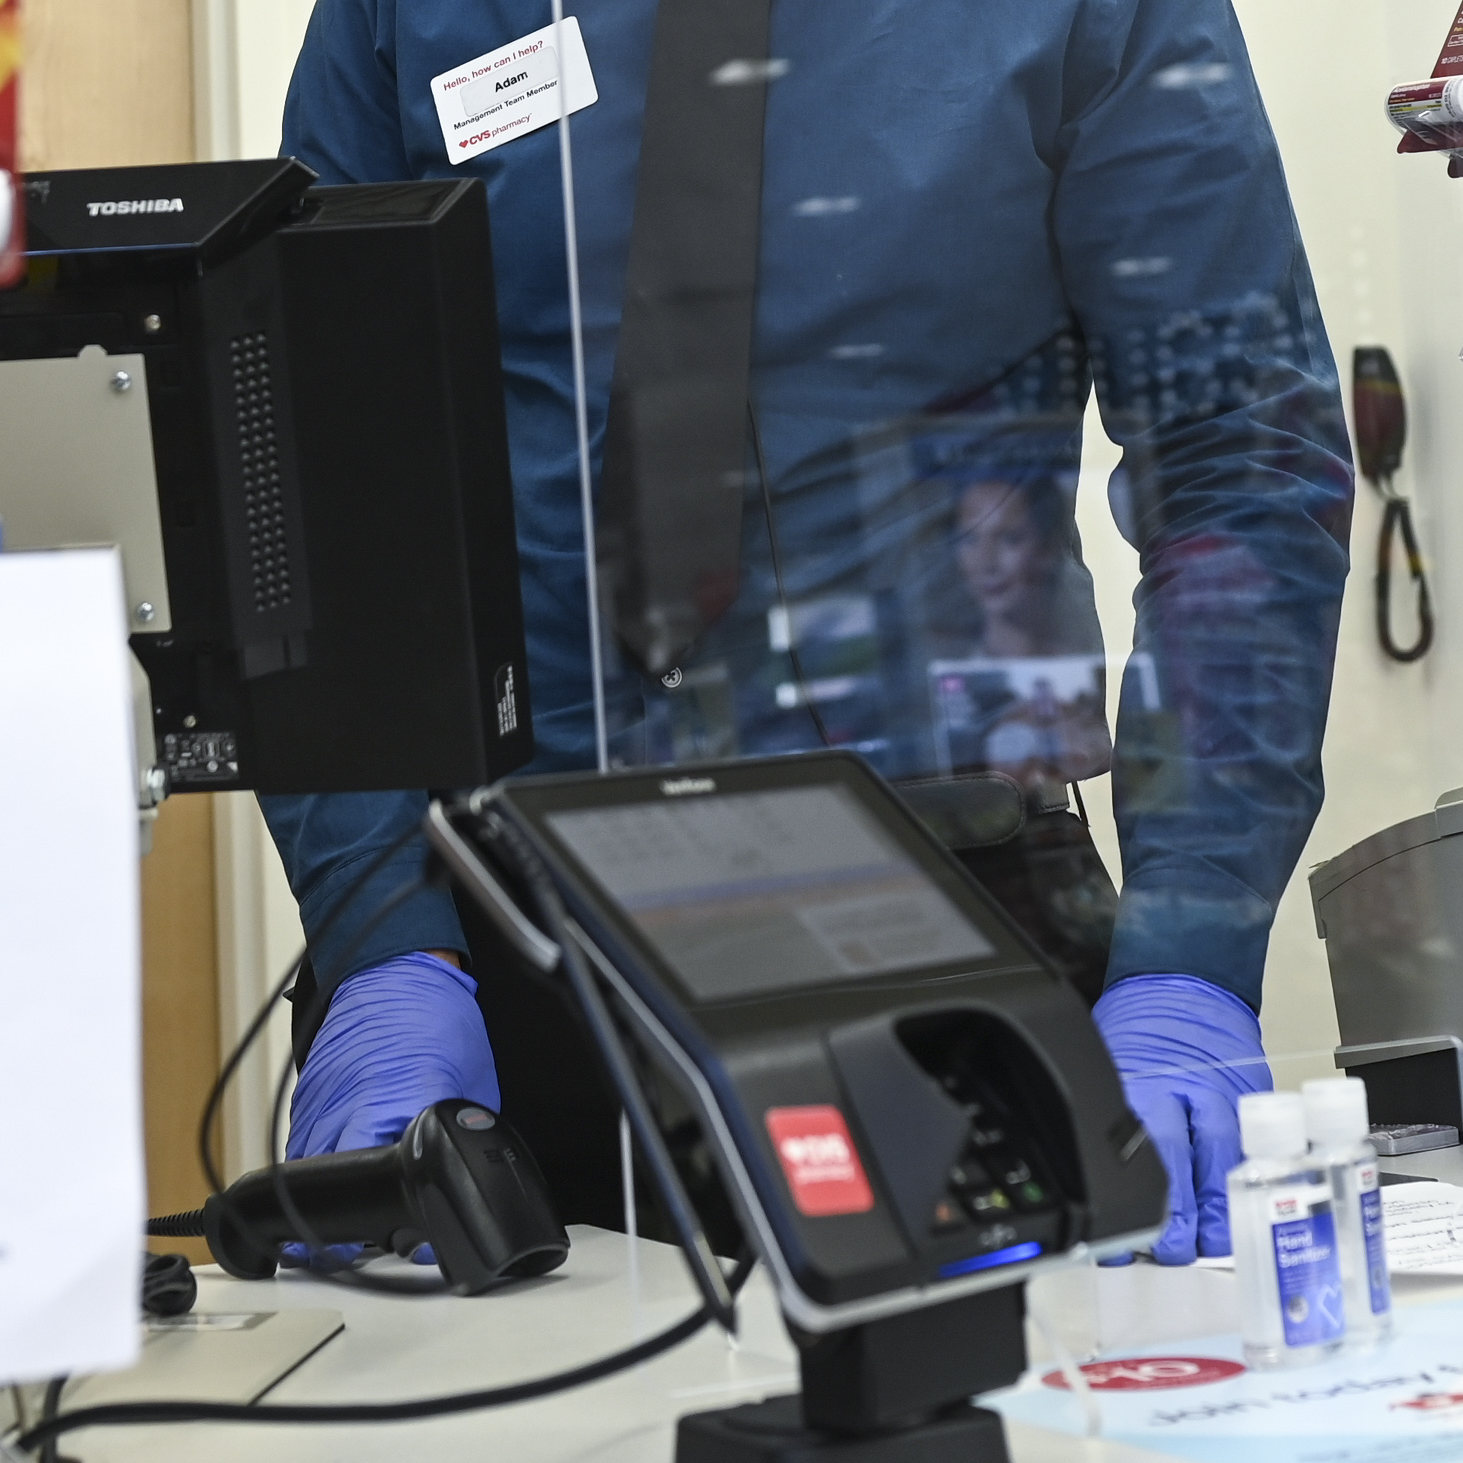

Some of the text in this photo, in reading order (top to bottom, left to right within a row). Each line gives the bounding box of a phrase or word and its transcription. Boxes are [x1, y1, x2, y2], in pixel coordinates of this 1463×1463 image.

[443, 75, 470, 91] Hello,
[472, 64, 492, 78] how
[494, 55, 511, 69] can
[518, 40, 544, 59] help?
[494, 70, 528, 93] Adam
[453, 80, 558, 130] Management Team Member
[469, 113, 531, 146] CVS pharmacy
[87, 197, 183, 217] TOSHIBA
